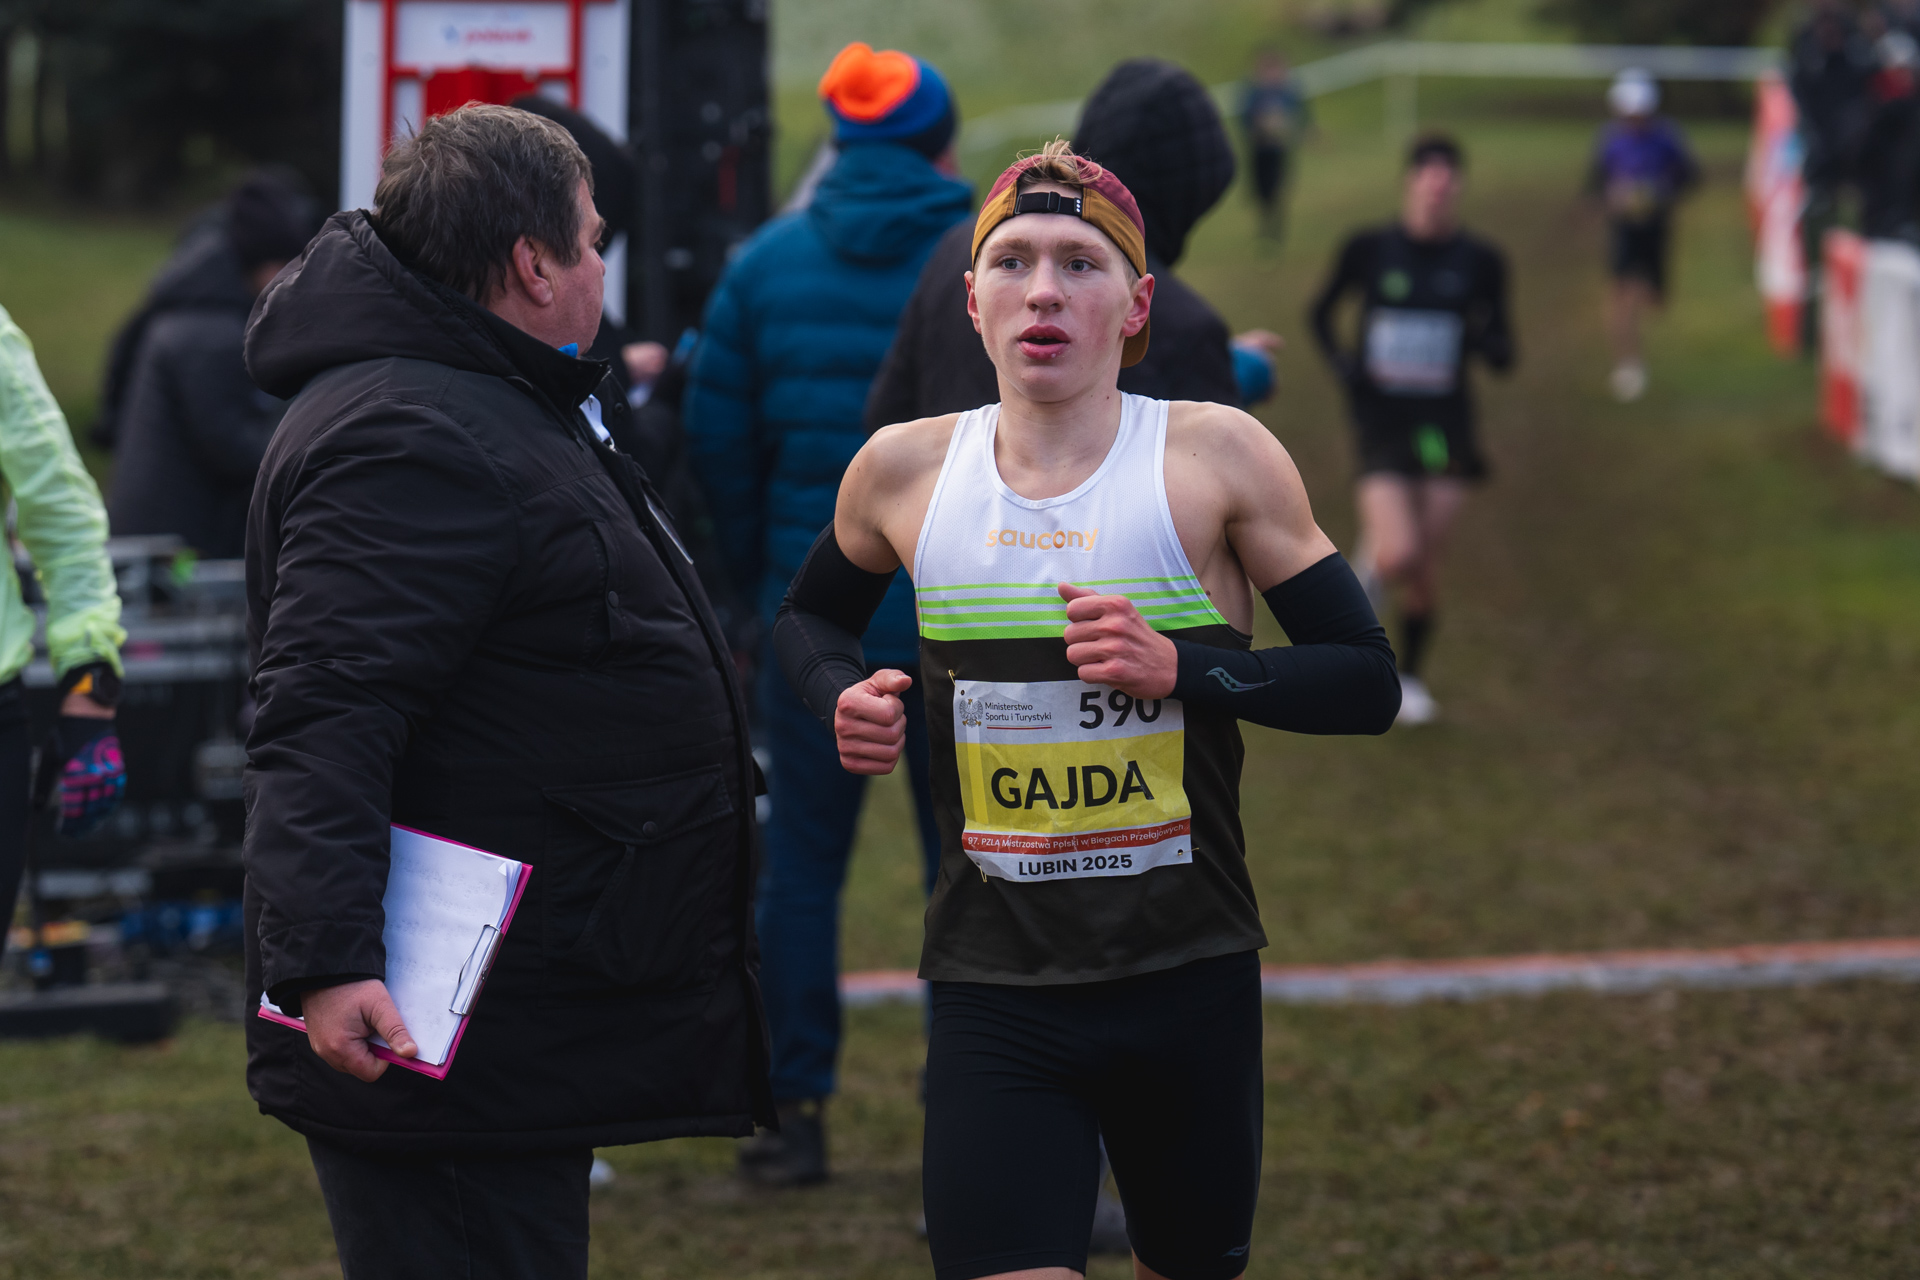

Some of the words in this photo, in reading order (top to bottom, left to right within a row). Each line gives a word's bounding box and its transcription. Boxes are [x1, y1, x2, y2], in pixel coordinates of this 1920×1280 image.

[985, 528, 1099, 551] saucony
[985, 702, 1033, 711] Ministerstwo
[985, 712, 1009, 721] Sportu
[1015, 712, 1052, 722] Turystyki
[1079, 689, 1161, 729] 590
[991, 760, 1155, 810] GAJDA
[967, 836, 980, 846] 97.
[1001, 839, 1051, 849] Mistrzostwa
[1053, 839, 1079, 848] Polski
[1090, 834, 1128, 845] Biegach
[1019, 859, 1077, 875] LUBIN
[1082, 854, 1133, 871] 2025
